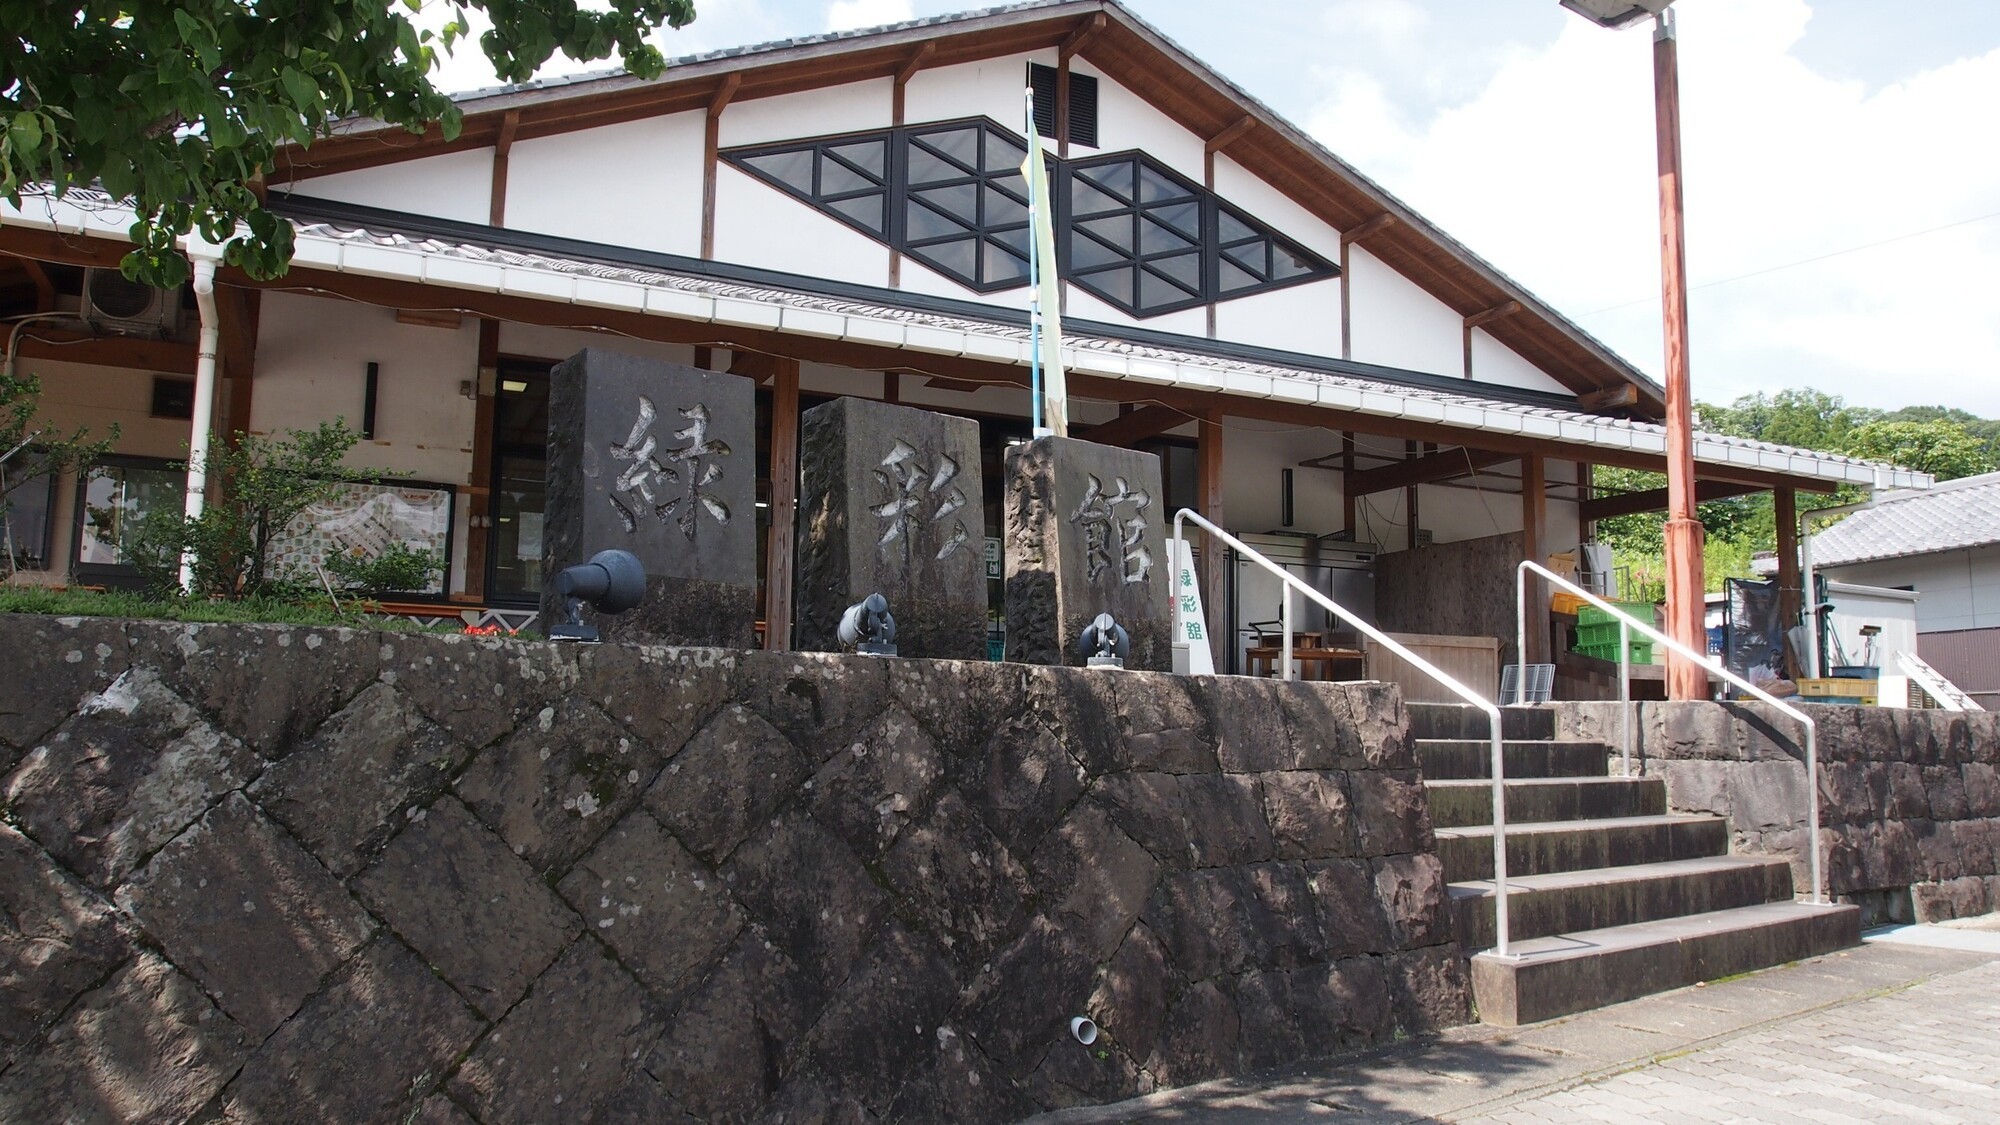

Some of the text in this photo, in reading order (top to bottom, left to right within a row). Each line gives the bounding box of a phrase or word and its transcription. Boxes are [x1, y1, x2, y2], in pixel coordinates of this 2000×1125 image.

[609, 394, 732, 542] 緑
[869, 437, 968, 560] 彩
[1069, 473, 1154, 585] 館
